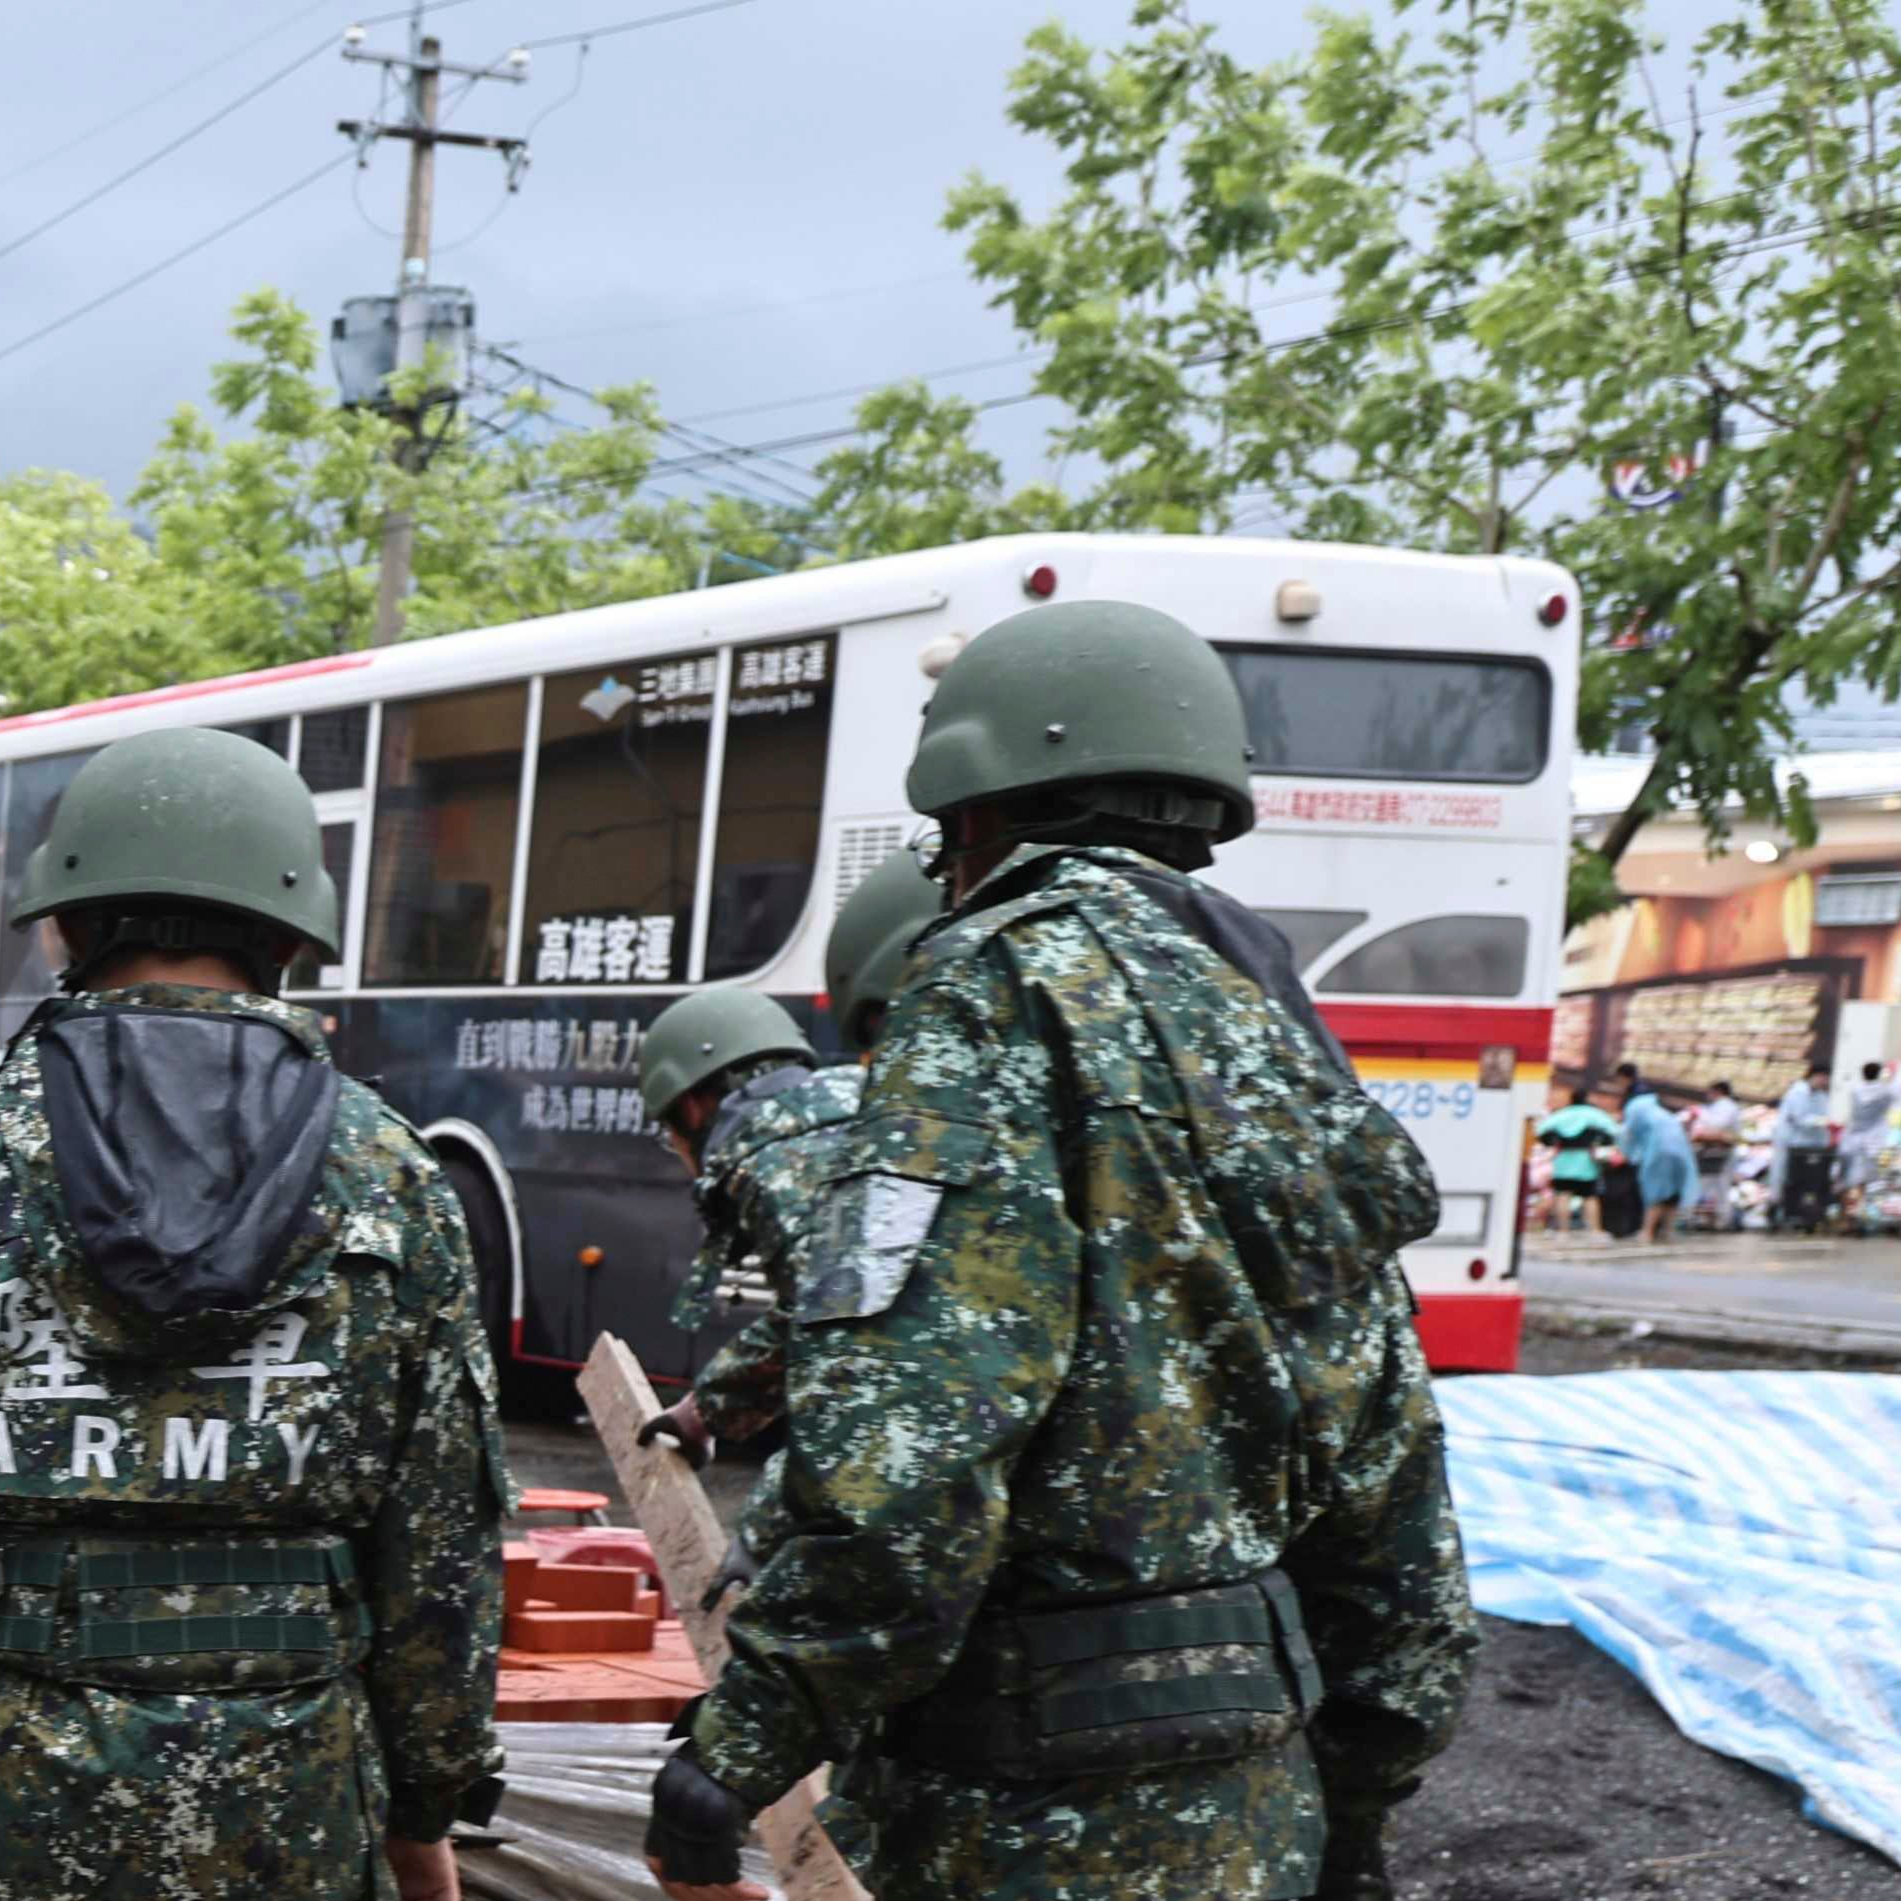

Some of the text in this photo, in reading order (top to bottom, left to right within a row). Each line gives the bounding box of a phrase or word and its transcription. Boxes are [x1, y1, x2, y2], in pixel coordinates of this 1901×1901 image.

[739, 640, 827, 689] 高雄客運
[535, 914, 676, 982] 高雄客運
[520, 1084, 660, 1136] 成為世界的
